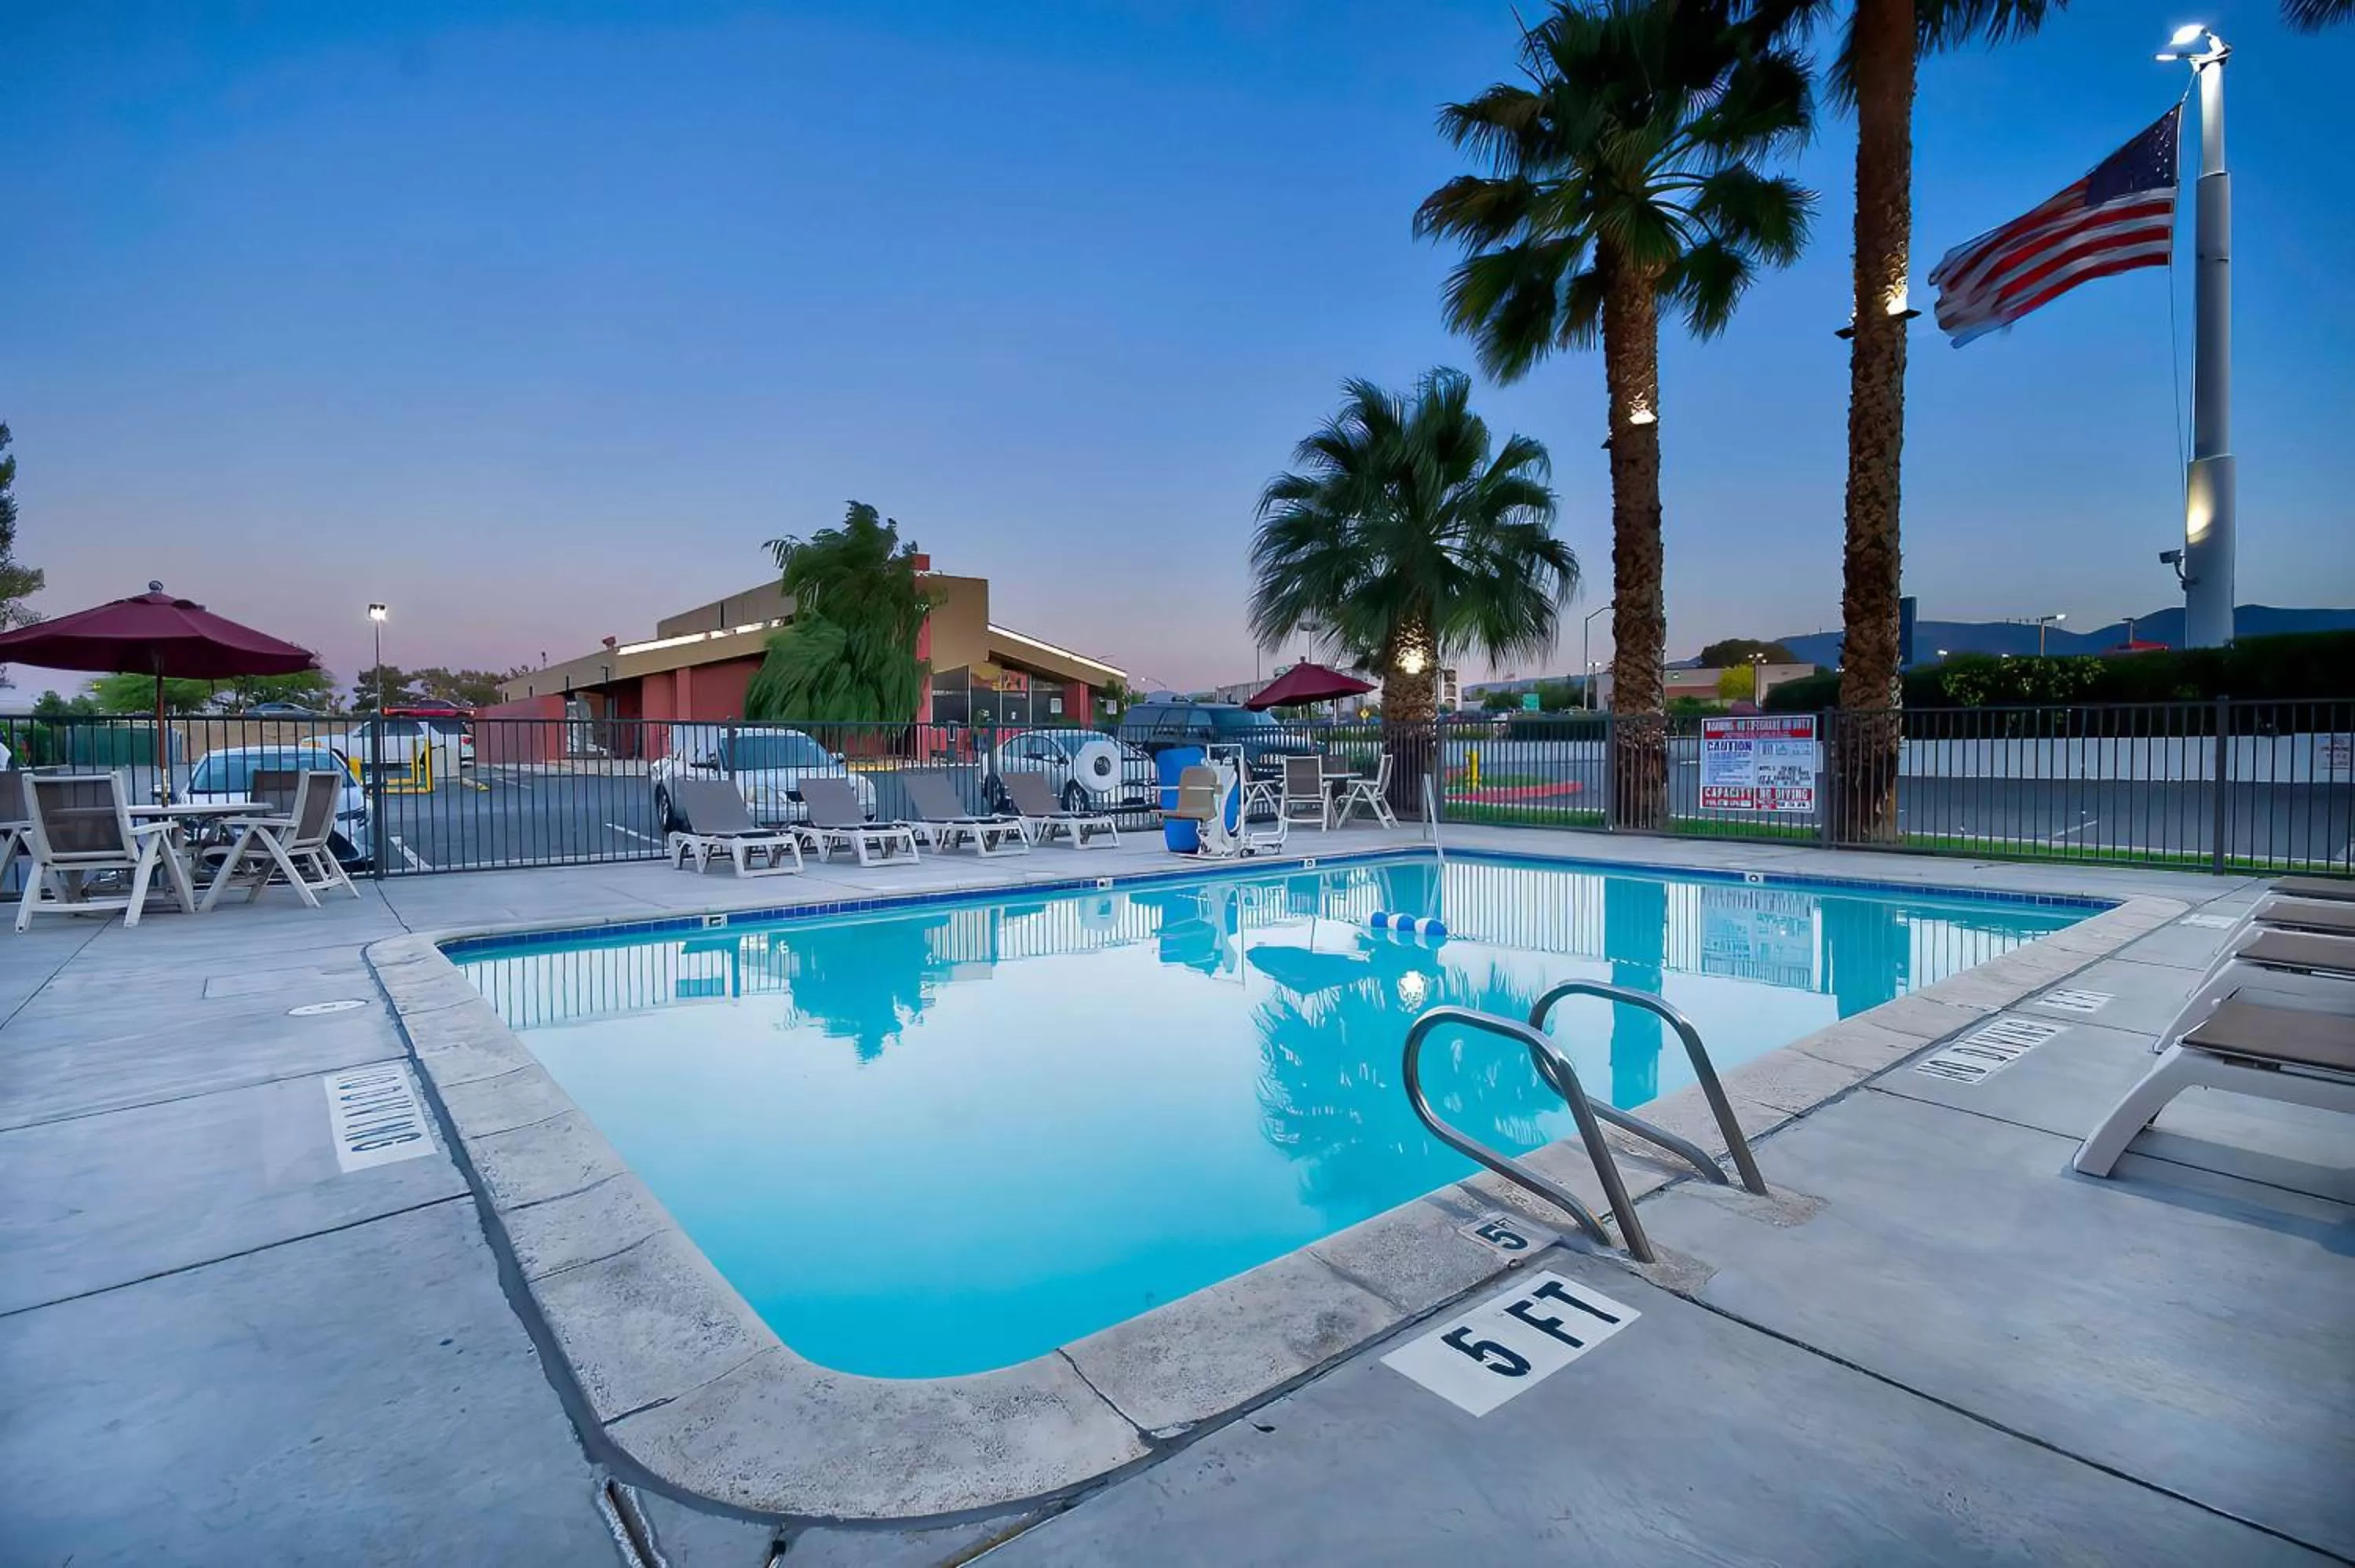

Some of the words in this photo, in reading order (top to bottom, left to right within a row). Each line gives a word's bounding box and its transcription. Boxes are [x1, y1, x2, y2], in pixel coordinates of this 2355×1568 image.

[1707, 740, 1752, 751] CAUTION
[1704, 787, 1752, 798] CAPACITY
[1775, 788, 1808, 800] DIVING
[1952, 1020, 2057, 1062] DIVING
[340, 1085, 422, 1152] DIVING
[1475, 1223, 1528, 1250] 5
[1440, 1326, 1532, 1377] 5
[1502, 1280, 1621, 1349] FT
